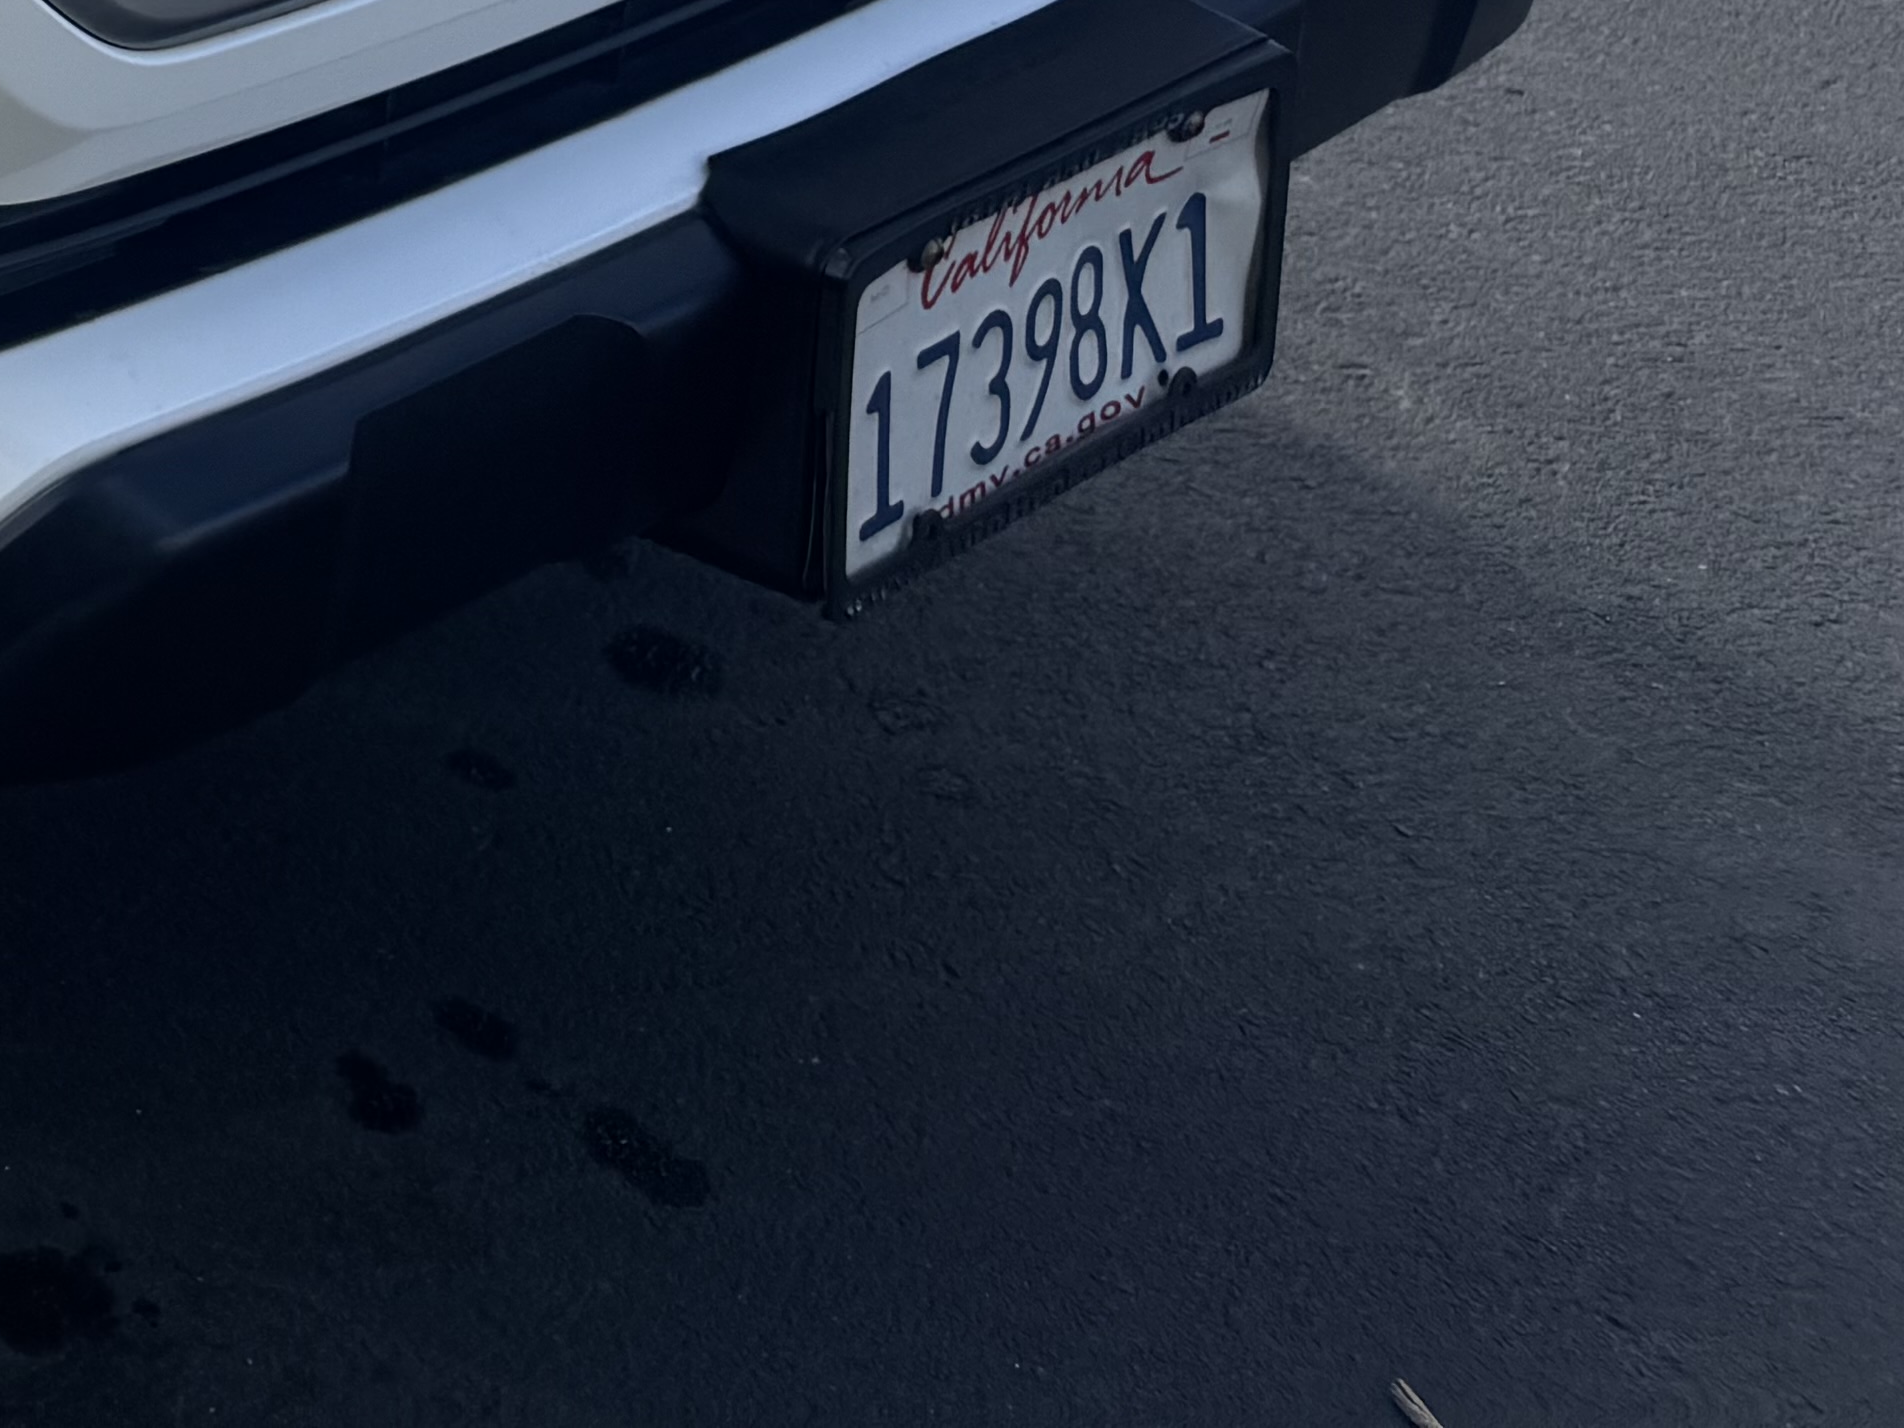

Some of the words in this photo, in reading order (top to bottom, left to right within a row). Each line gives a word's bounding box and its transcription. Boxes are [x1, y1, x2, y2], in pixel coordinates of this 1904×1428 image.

[920, 149, 1184, 310] California
[859, 192, 1224, 542] 17398K1
[938, 385, 1146, 520] dmv.ca.gov
